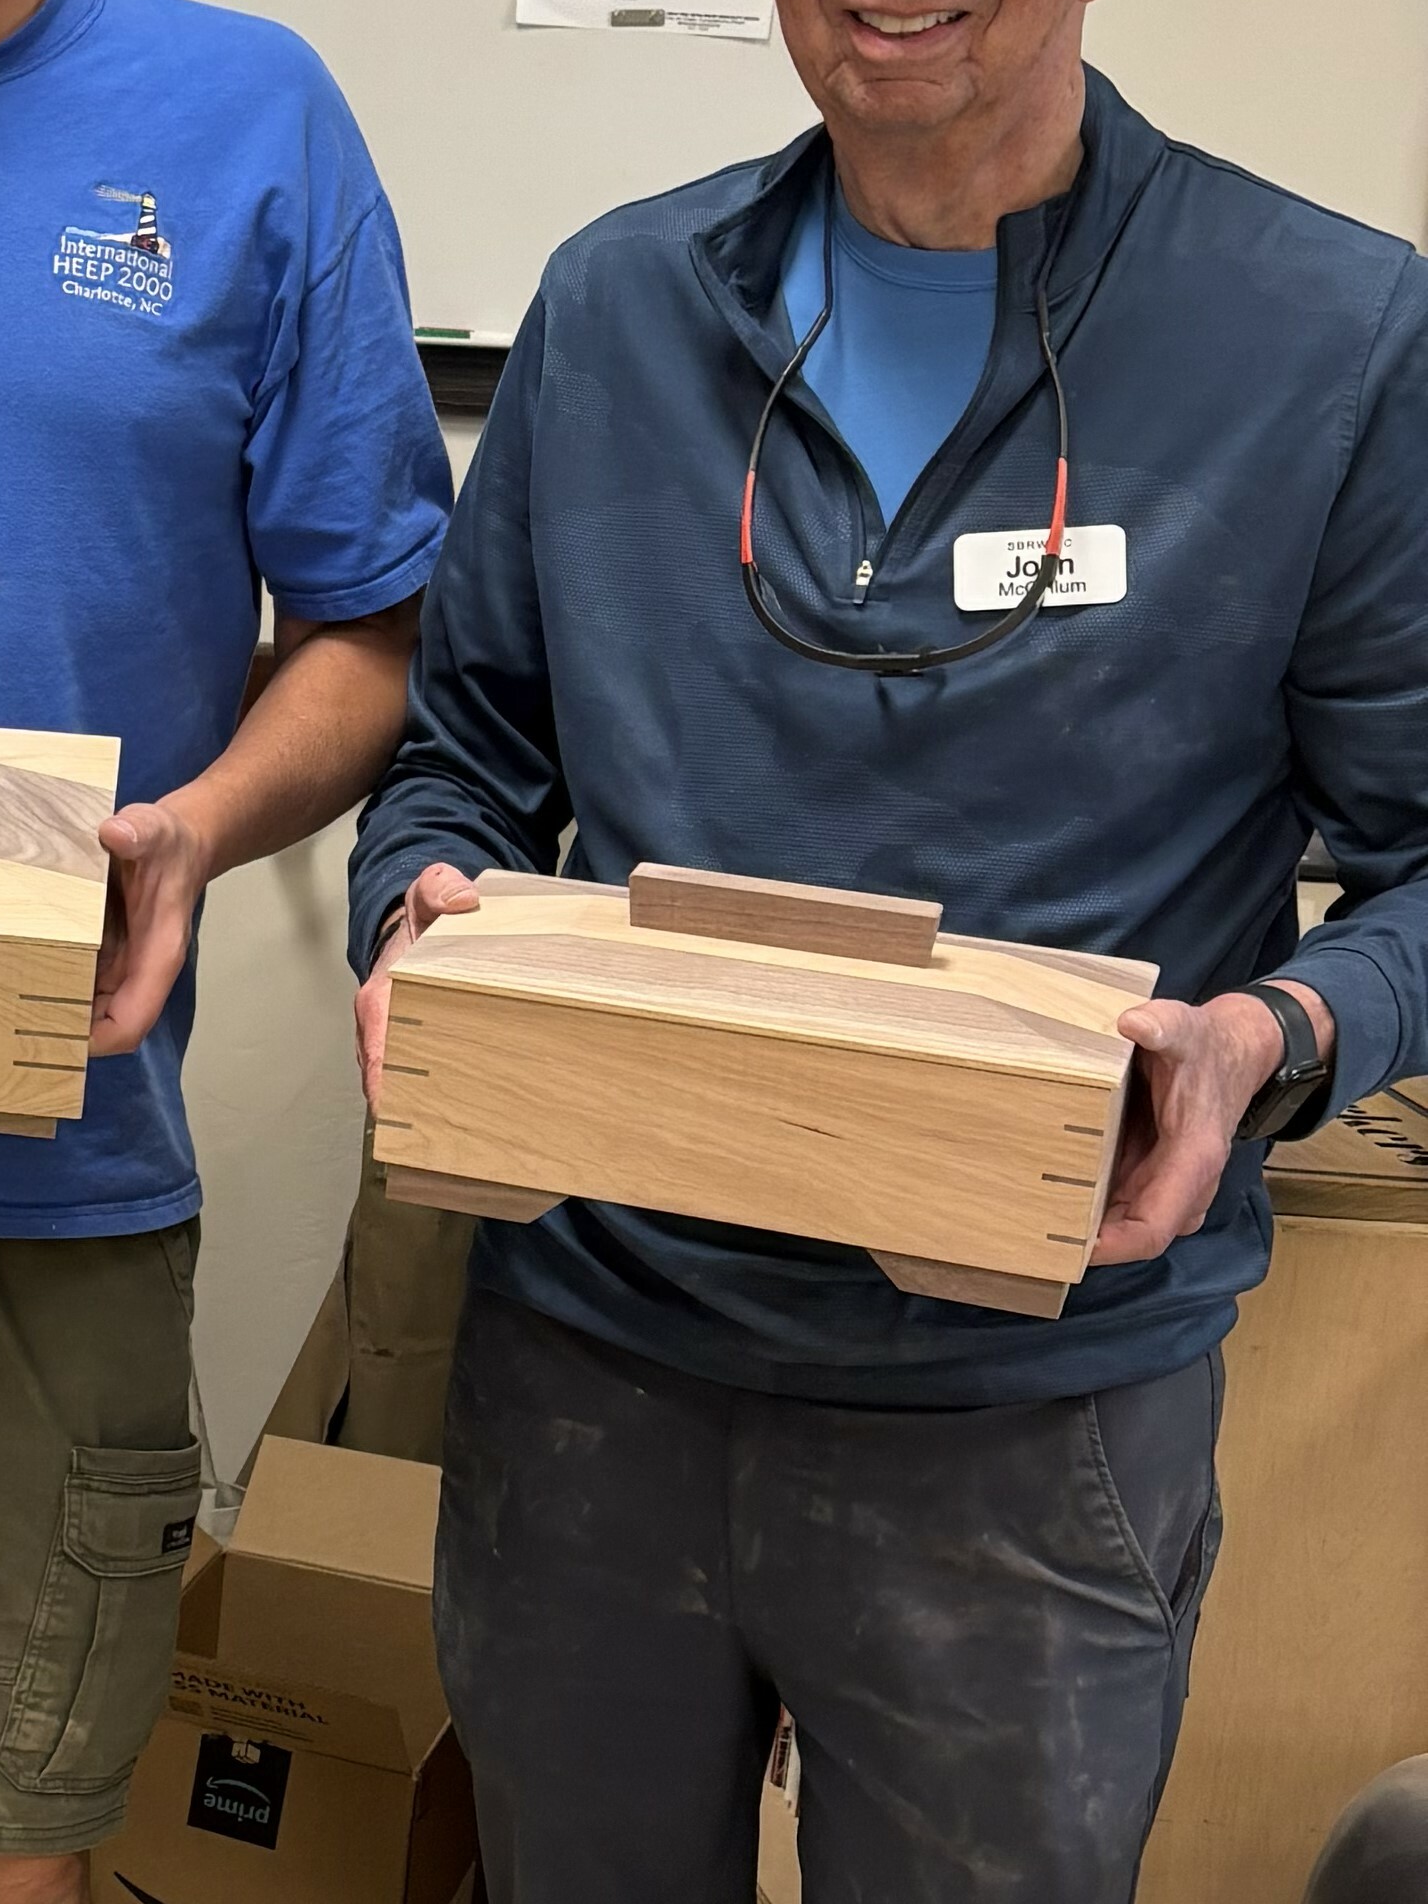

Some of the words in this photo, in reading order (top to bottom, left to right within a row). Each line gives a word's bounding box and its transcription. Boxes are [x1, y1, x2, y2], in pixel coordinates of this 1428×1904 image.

[61, 235, 173, 280] International
[53, 254, 114, 281] HEEP
[117, 267, 173, 301] 2000
[62, 280, 136, 311] Charlotte,
[139, 297, 163, 316] NC
[1006, 555, 1075, 578] Jon
[210, 1686, 328, 1725] MATERIAL
[243, 1685, 306, 1710] WITH
[204, 1793, 270, 1823] prime
